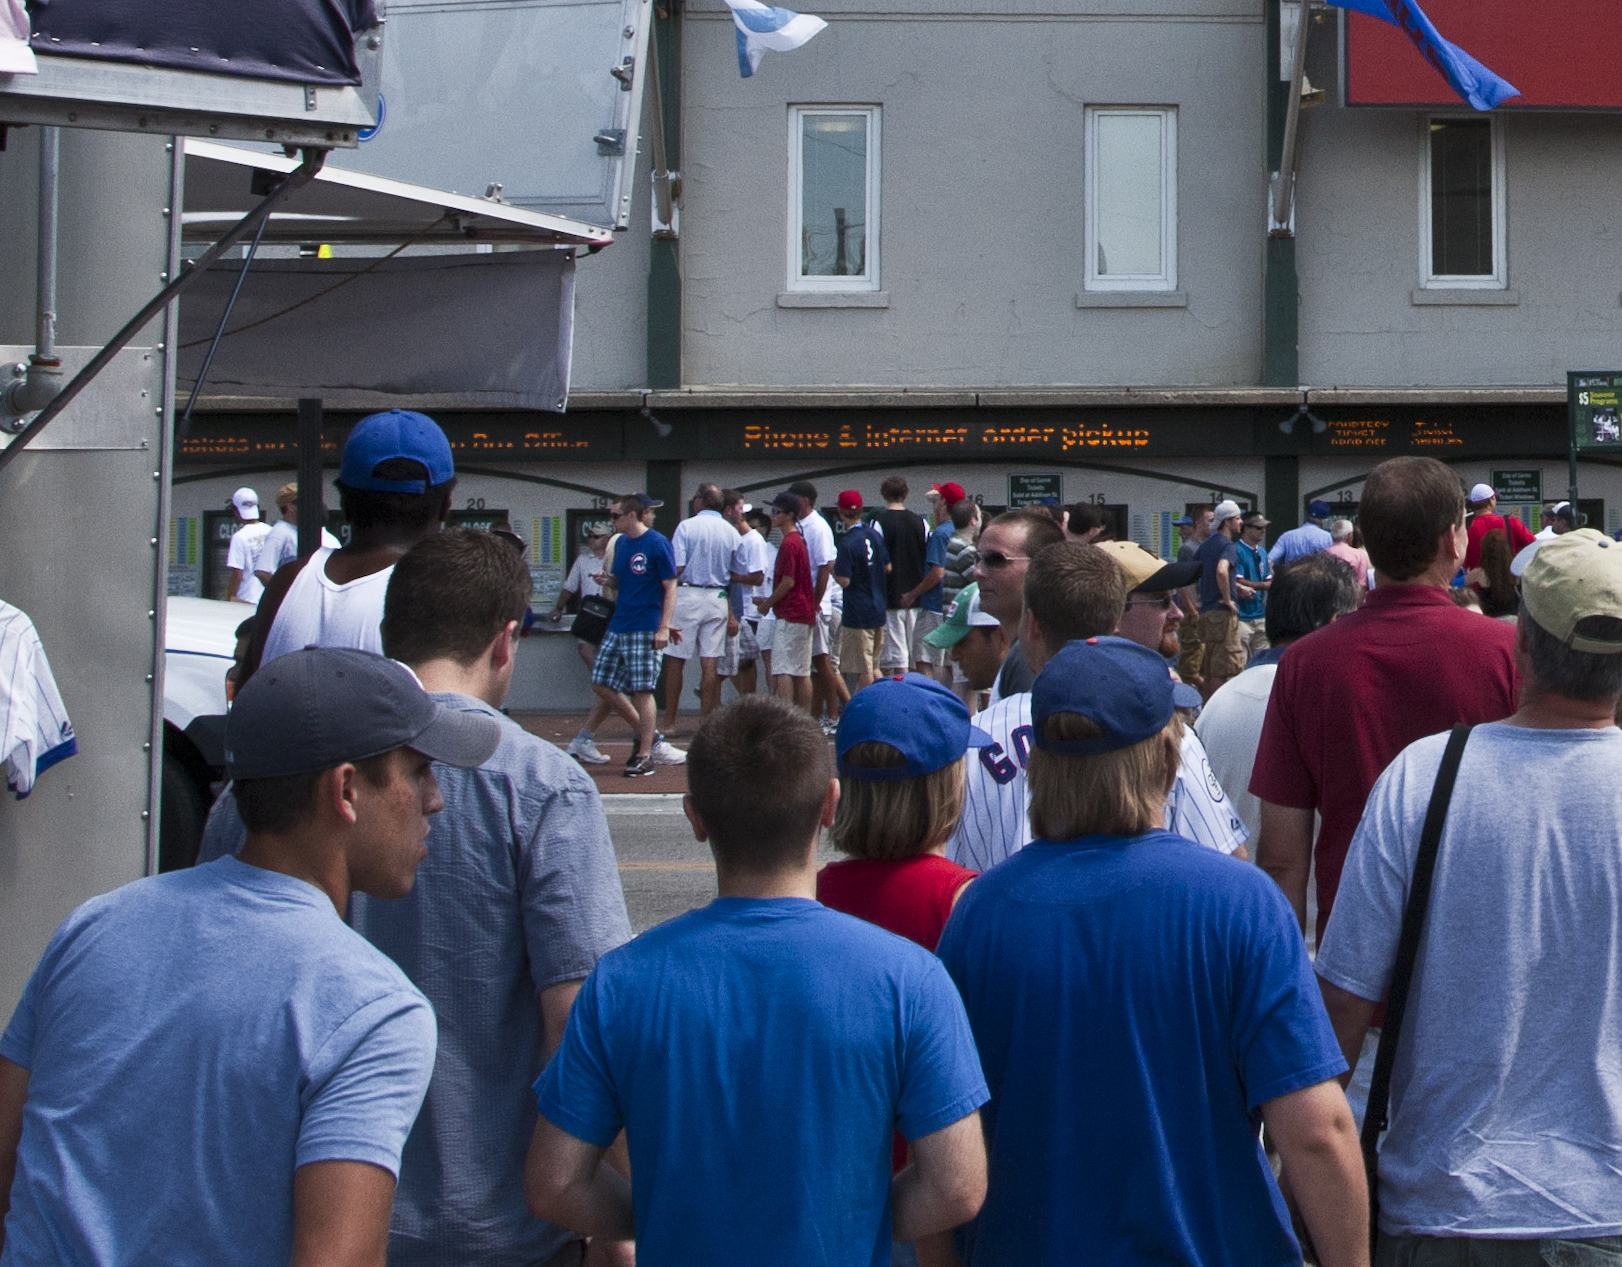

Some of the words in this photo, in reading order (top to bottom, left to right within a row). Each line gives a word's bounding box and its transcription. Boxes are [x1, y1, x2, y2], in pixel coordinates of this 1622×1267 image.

[1578, 390, 1589, 405] $5
[745, 425, 828, 448] Phone
[1062, 423, 1149, 450] pickup
[1089, 492, 1105, 505] 15
[1209, 492, 1224, 504] 14
[1337, 490, 1352, 501] 13
[467, 498, 486, 510] 20
[591, 497, 608, 509] 19
